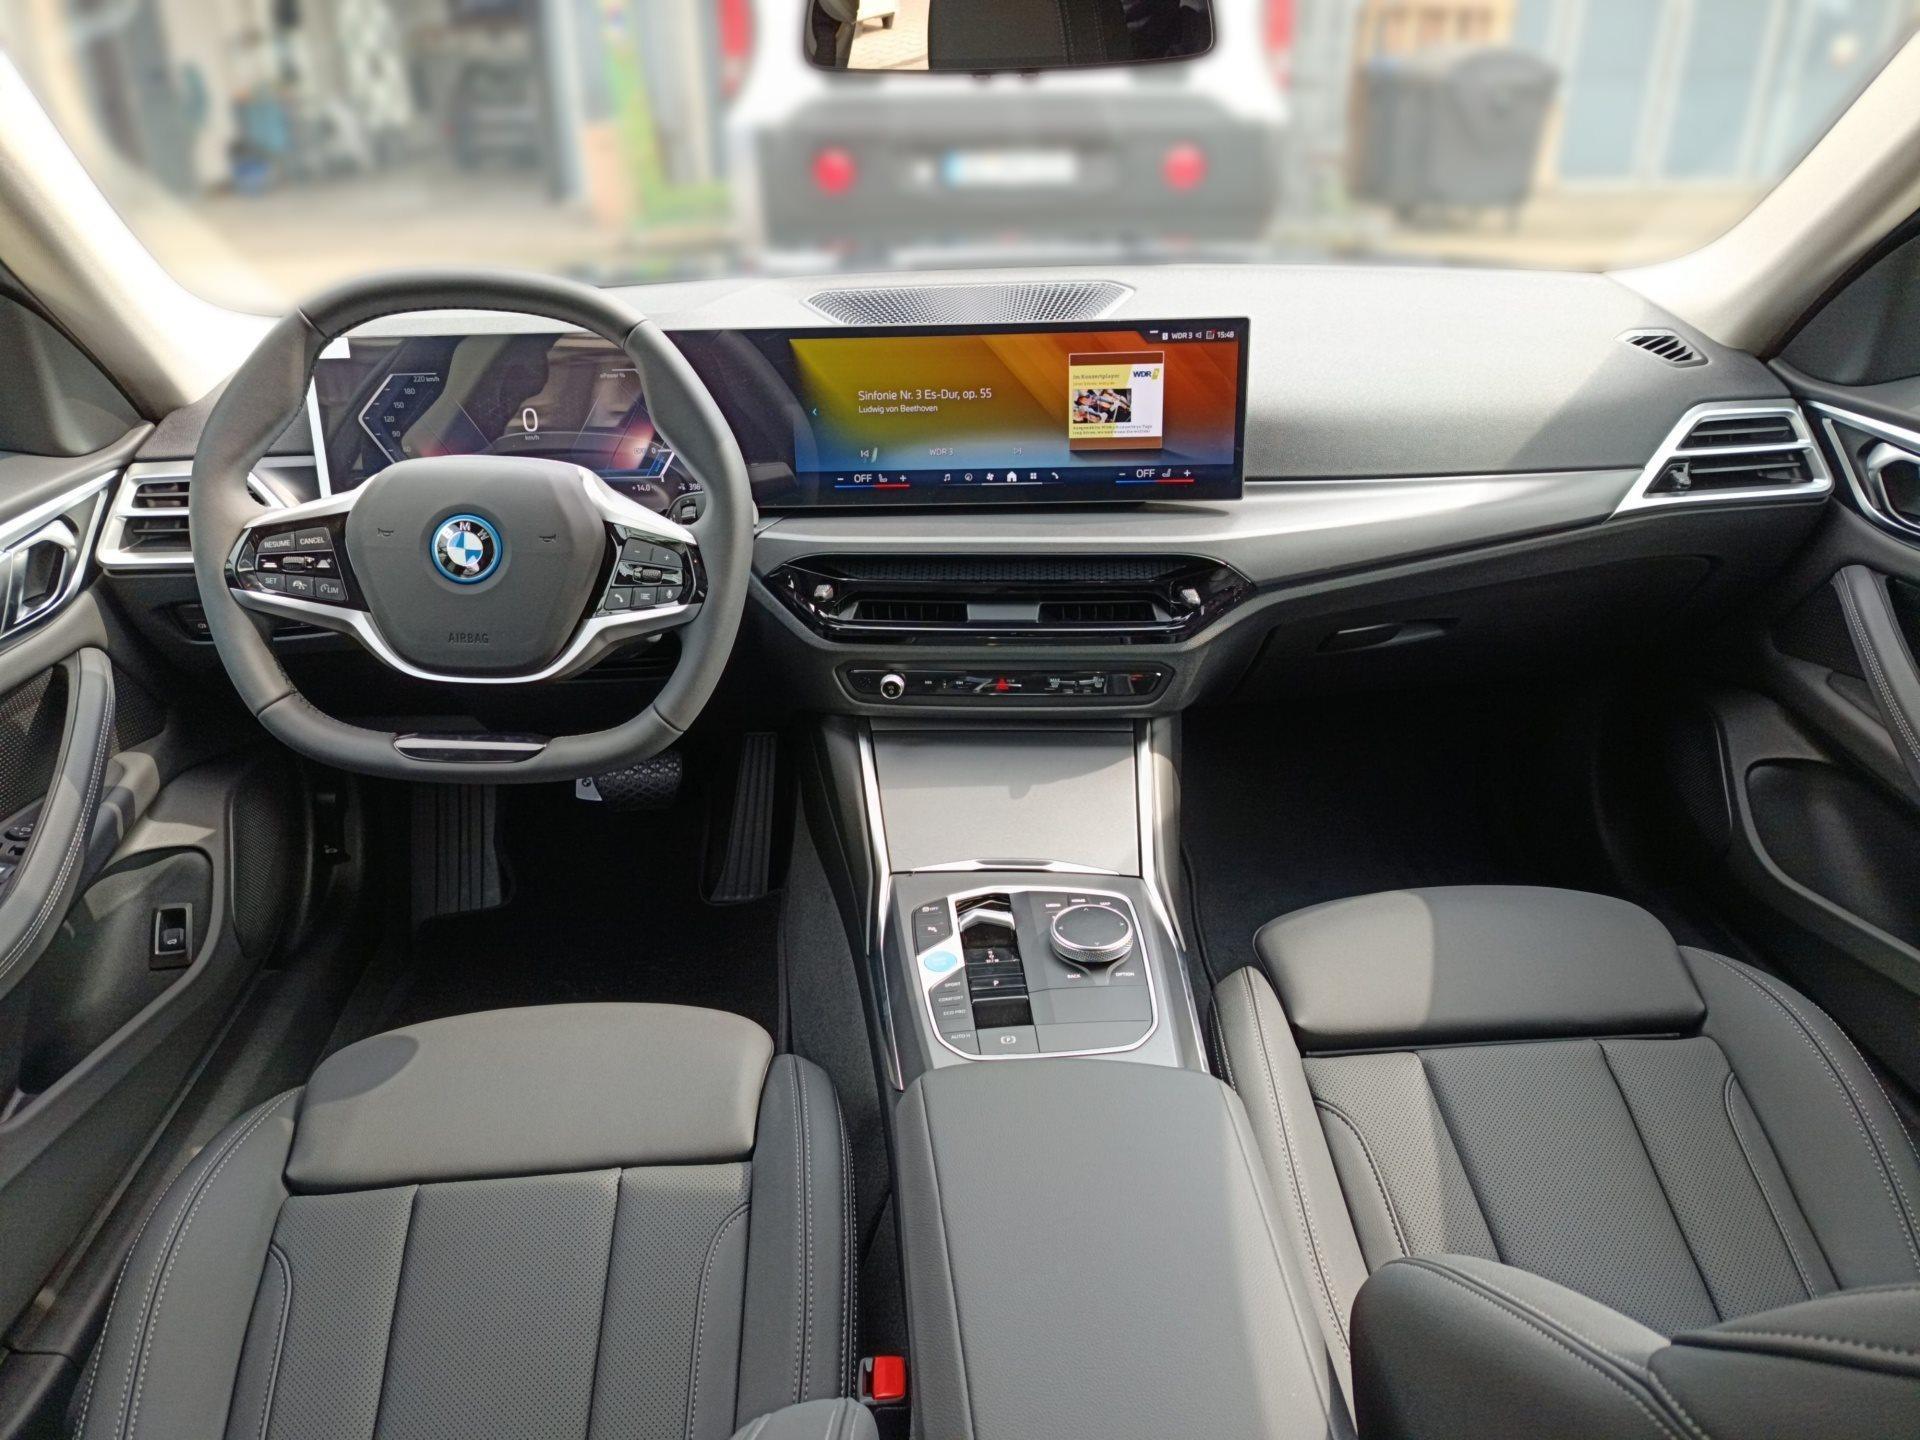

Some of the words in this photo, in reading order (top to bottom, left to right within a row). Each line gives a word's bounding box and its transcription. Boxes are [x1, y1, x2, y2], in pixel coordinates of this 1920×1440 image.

[1133, 370, 1152, 378] WDR
[858, 390, 897, 401] Sinfonie
[900, 390, 914, 400] Nr.
[916, 390, 922, 399] 3
[924, 389, 961, 401] Es-Dur,
[962, 390, 977, 400] op.
[980, 388, 992, 399] 55
[858, 405, 884, 414] Ludwig
[900, 404, 938, 413] Beethoven
[522, 407, 539, 432] 0
[929, 448, 947, 456] WDR
[1136, 469, 1155, 478] OFF
[854, 474, 872, 483] OFF
[264, 539, 291, 548] RESUME
[300, 537, 325, 545] CANCEL
[265, 577, 277, 585] SET
[448, 632, 489, 643] AIRBAG
